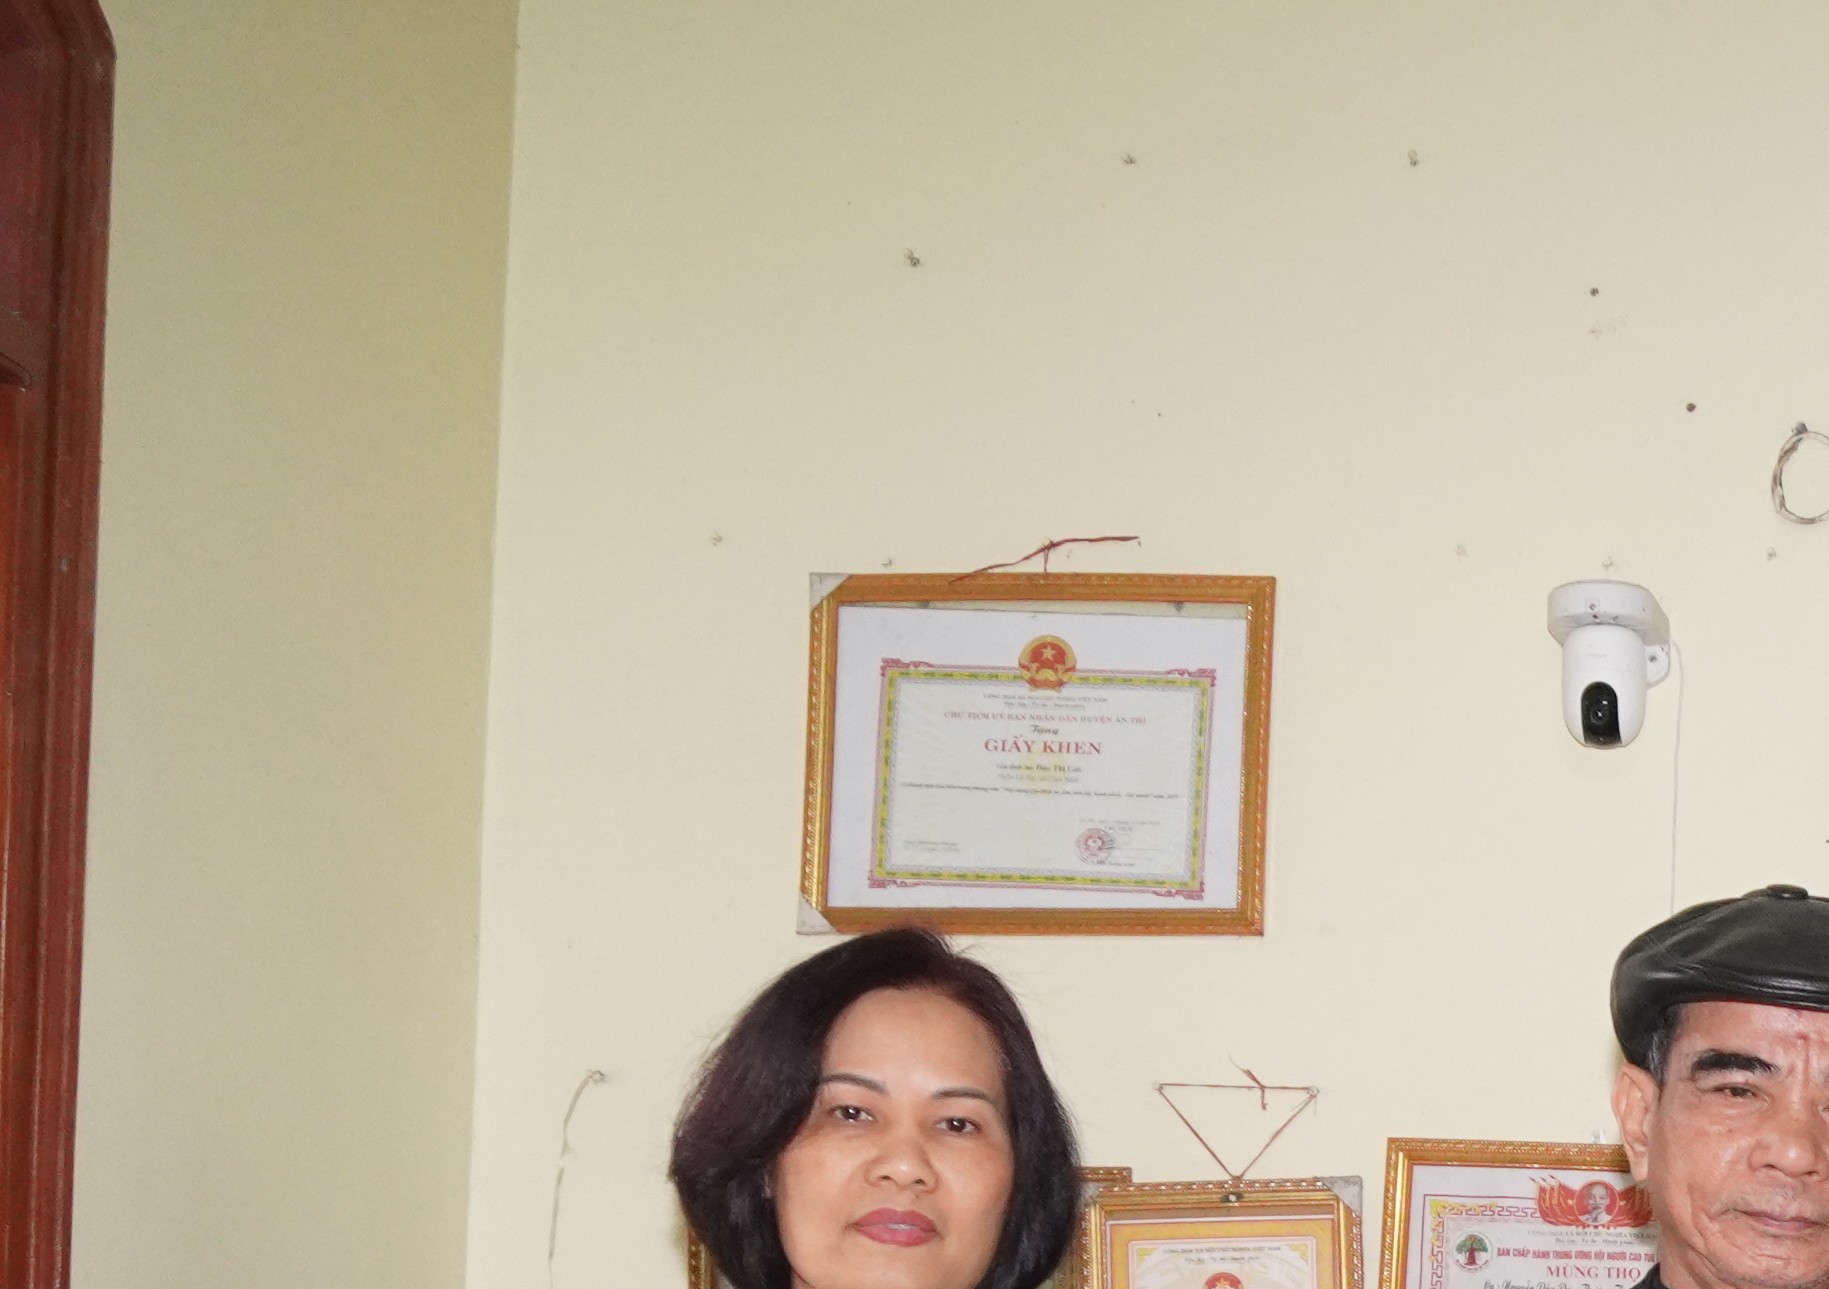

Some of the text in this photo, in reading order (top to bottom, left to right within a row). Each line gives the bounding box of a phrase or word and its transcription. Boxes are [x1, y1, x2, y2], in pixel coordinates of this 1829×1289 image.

[984, 734, 1102, 755] GIẤY KHEN
[1497, 1248, 1510, 1256] BAN
[1606, 1267, 1641, 1283] THỌ
